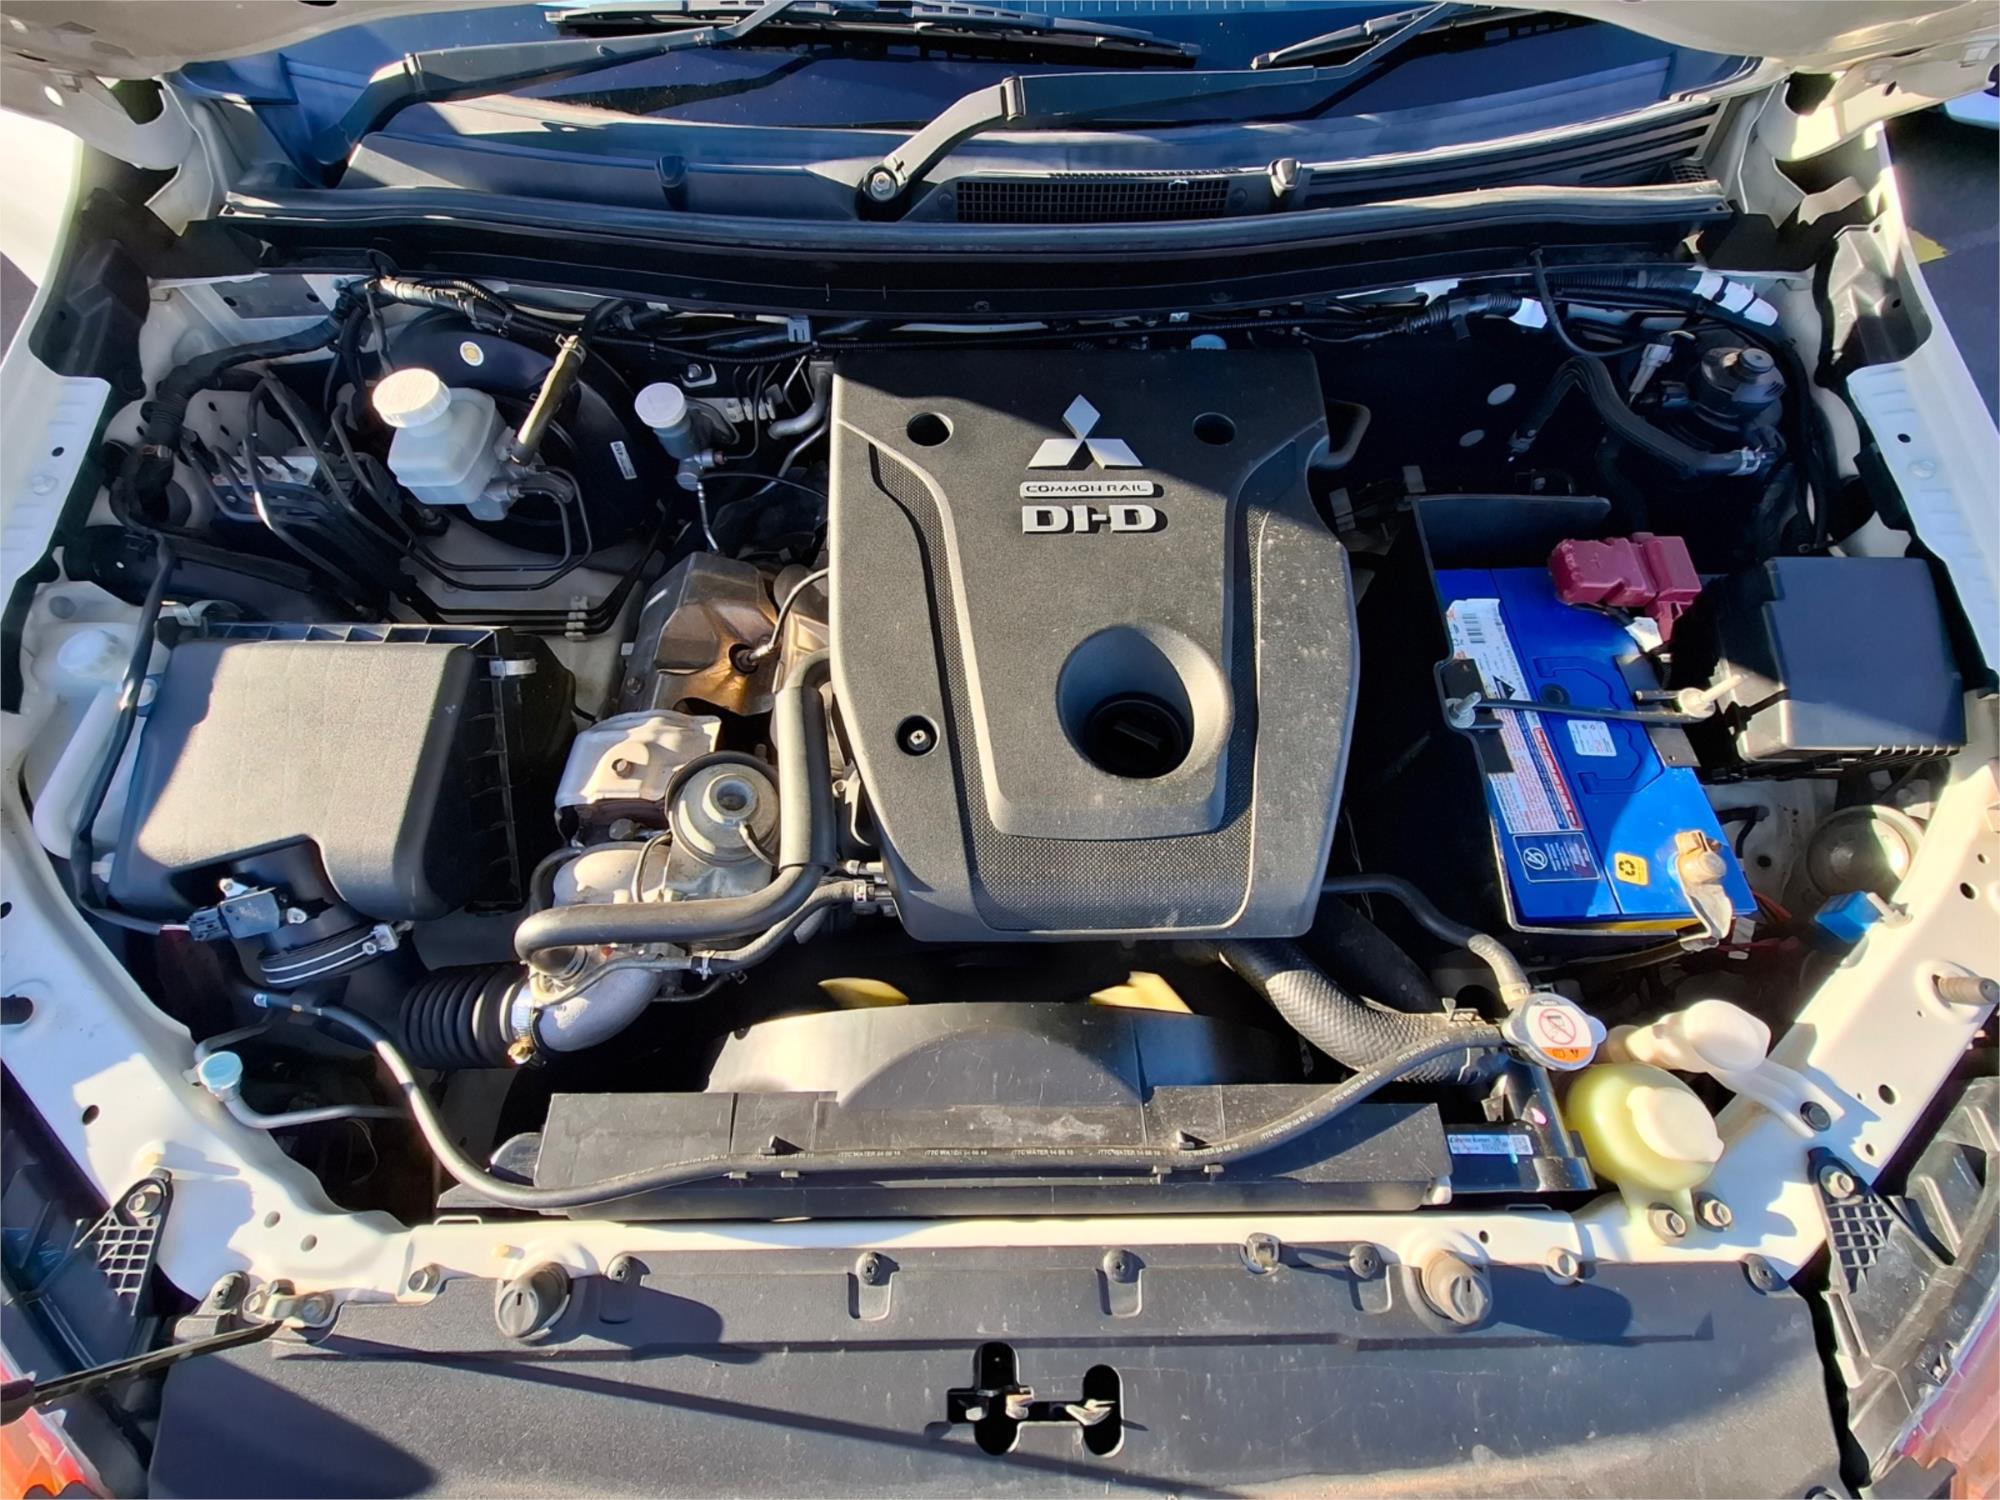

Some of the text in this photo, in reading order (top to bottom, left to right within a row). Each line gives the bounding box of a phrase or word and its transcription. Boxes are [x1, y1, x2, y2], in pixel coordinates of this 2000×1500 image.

[1025, 484, 1149, 493] COMMON RAIL
[1022, 504, 1157, 533] DI-D
